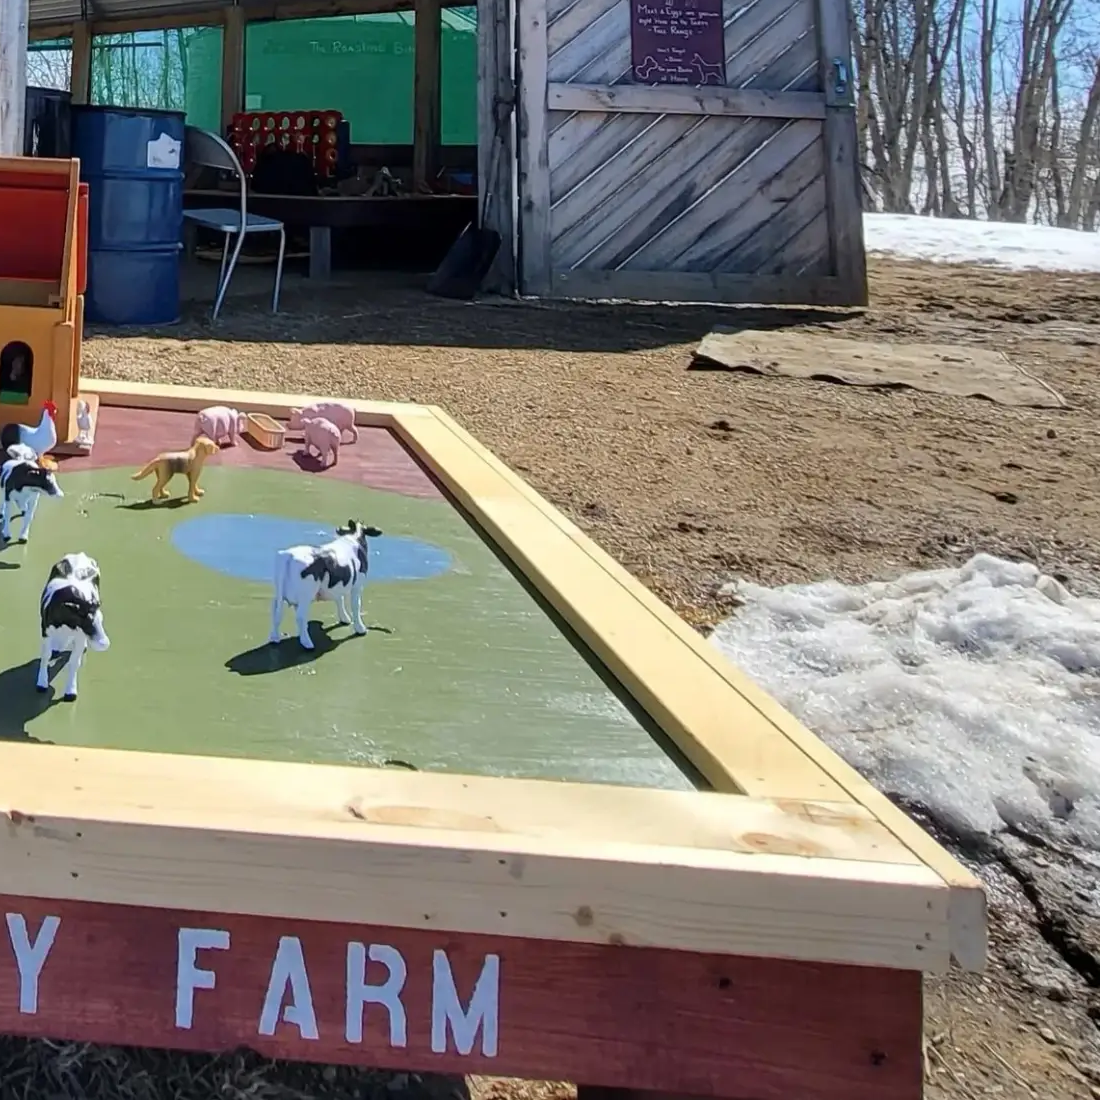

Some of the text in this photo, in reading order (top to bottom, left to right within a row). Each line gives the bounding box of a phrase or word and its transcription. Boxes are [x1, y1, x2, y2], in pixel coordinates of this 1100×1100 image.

[637, 4, 658, 15] Meat
[666, 6, 683, 19] Eggs
[173, 927, 501, 1057] FARM
